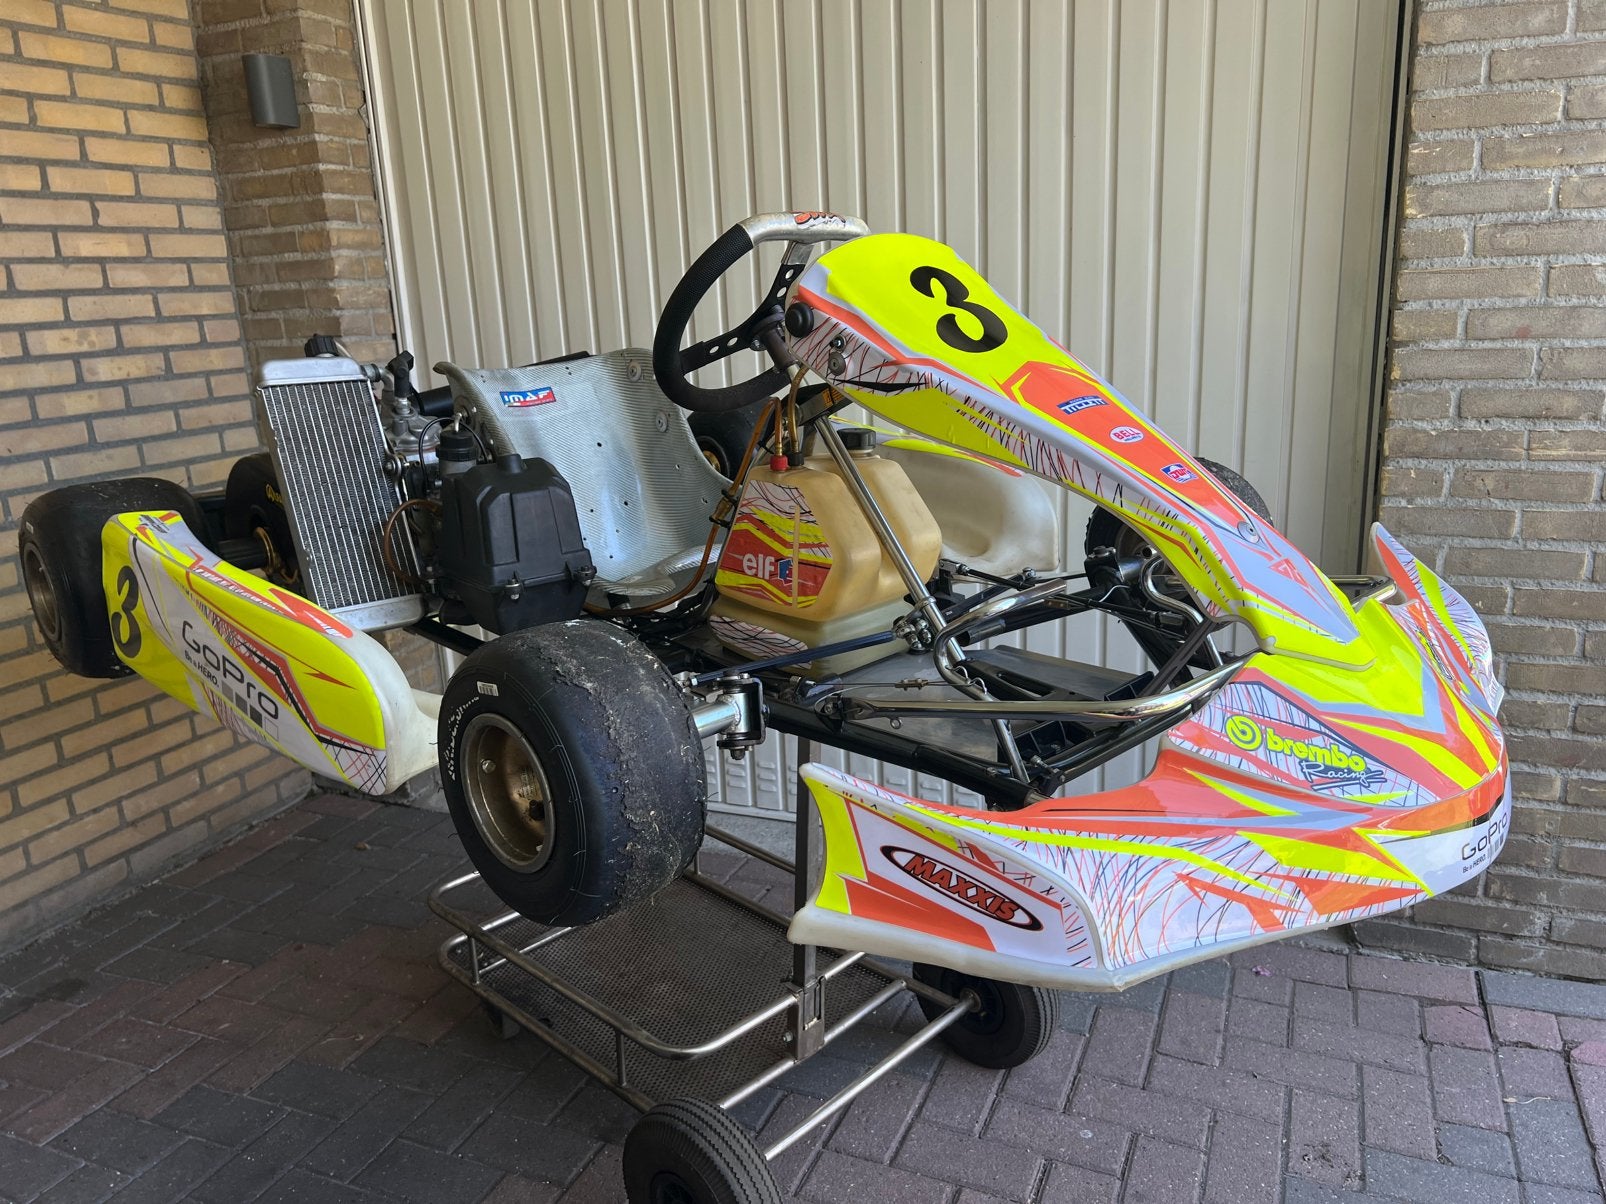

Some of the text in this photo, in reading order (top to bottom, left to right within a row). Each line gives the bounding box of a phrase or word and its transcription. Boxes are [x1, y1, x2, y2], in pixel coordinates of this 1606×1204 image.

[909, 265, 1008, 353] 3
[1112, 428, 1141, 440] BELL
[743, 553, 775, 580] elf
[110, 565, 142, 659] 3
[182, 620, 279, 720] GoPro
[1265, 727, 1367, 773] brembo
[1301, 760, 1383, 787] Racing
[1461, 812, 1508, 861] GoPro
[904, 854, 1020, 921] MAXXIS
